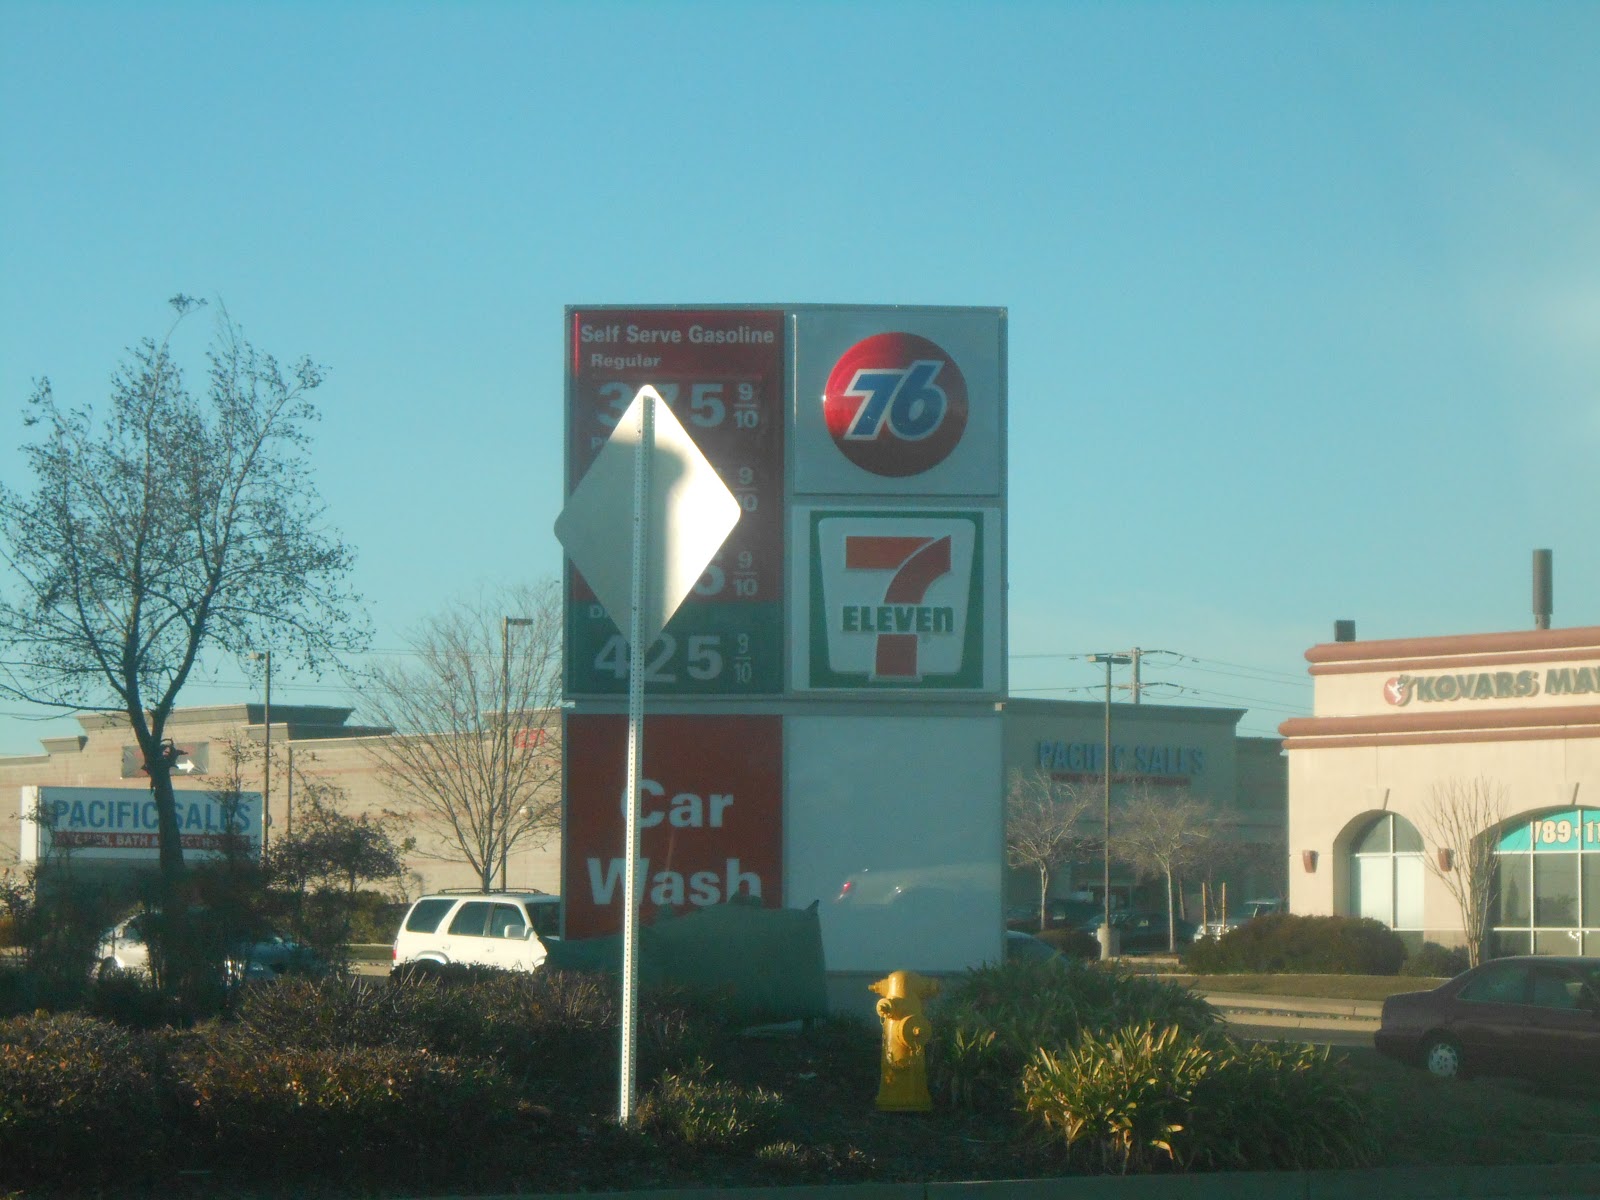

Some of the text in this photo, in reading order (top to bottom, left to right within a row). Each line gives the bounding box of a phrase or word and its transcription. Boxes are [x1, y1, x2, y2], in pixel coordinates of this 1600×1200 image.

[581, 325, 775, 343] Self Serve Gasoline
[591, 353, 661, 370] Regular
[738, 383, 754, 401] 9
[843, 360, 945, 440] 76
[733, 410, 760, 429] 10
[733, 578, 759, 597] 10
[593, 632, 724, 683] 425
[1545, 666, 1600, 695] MA
[1037, 739, 1124, 771] PACIFC
[54, 799, 158, 829] PACIFIC
[620, 779, 734, 829] Car
[587, 857, 762, 906] Wash
